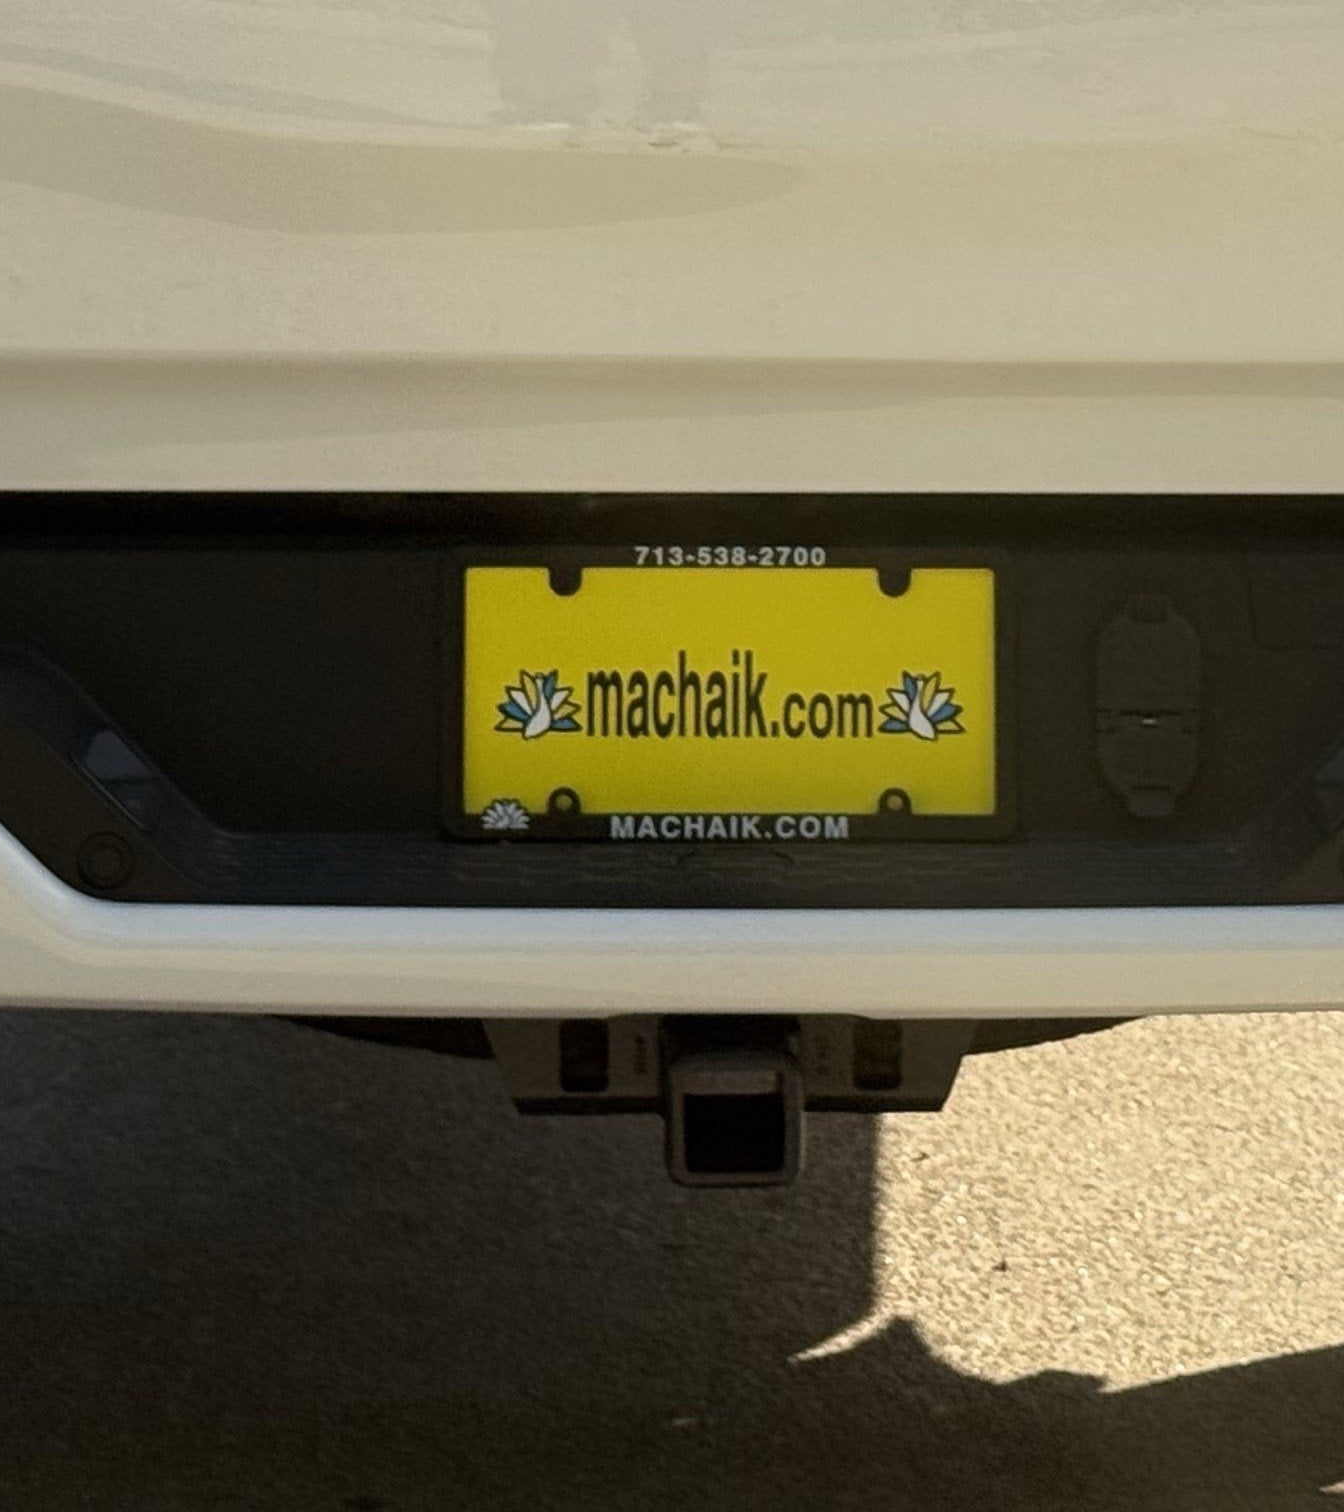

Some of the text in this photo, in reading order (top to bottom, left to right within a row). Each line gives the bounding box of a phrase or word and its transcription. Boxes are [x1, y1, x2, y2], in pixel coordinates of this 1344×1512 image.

[635, 547, 826, 566] 713-538-2700
[586, 650, 874, 738] machaik.com
[610, 816, 849, 840] MACHAIK.COM
